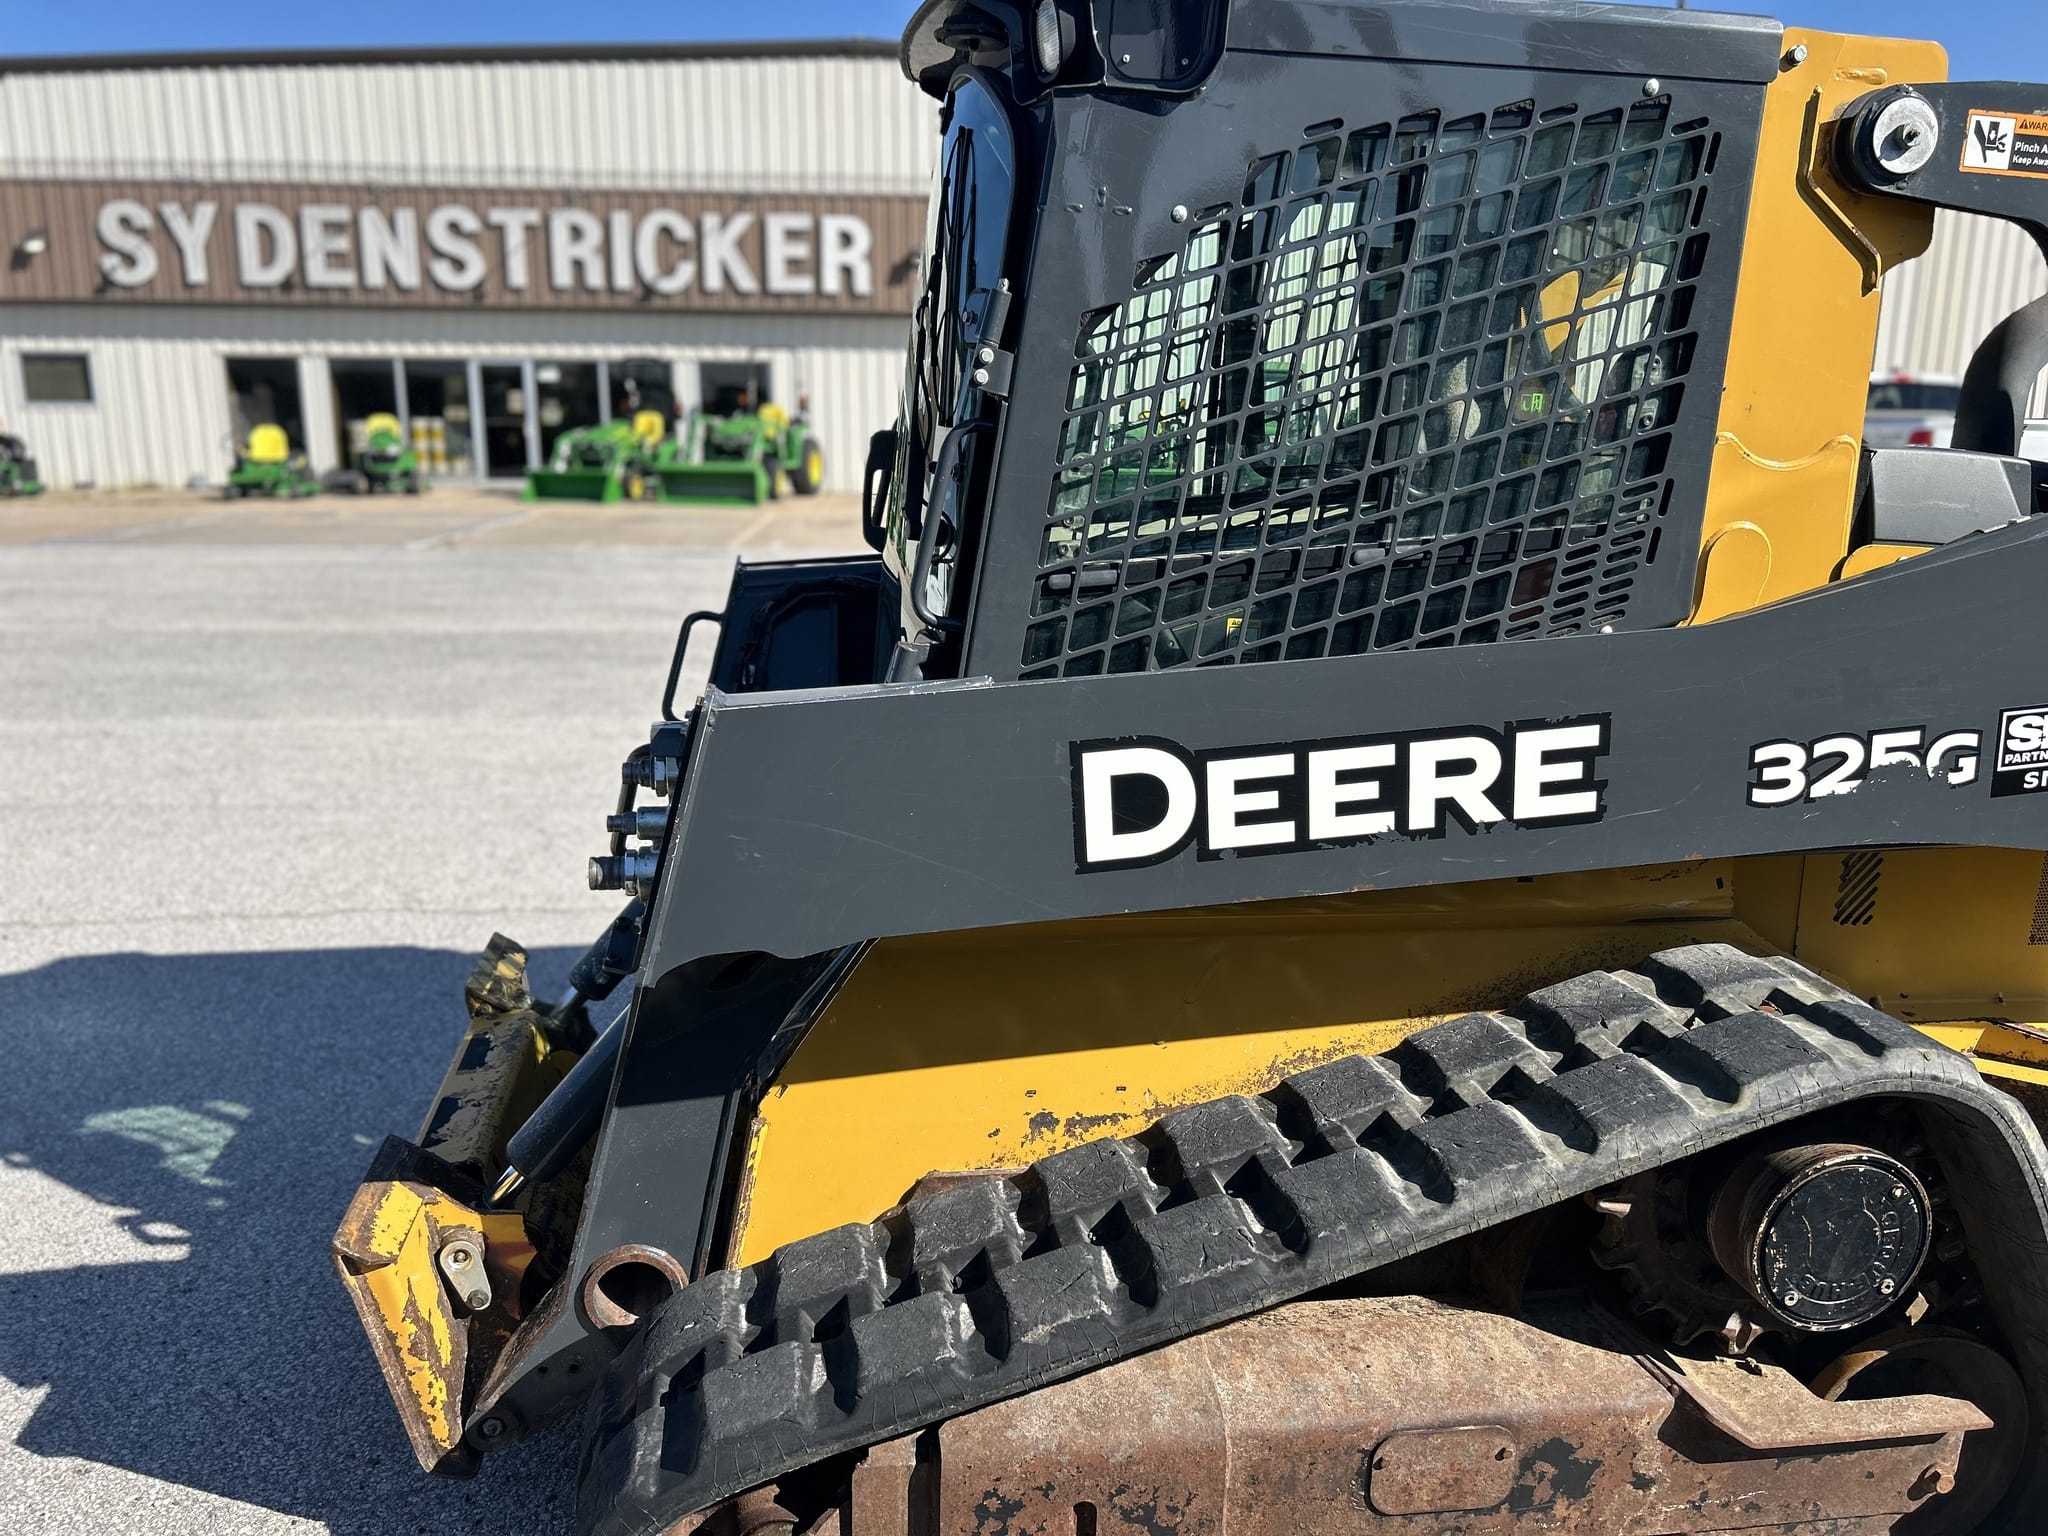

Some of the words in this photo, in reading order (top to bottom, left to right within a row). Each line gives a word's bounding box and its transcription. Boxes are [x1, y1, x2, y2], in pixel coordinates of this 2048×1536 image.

[2012, 154, 2032, 166] Keep
[2015, 142, 2040, 153] Pinch
[1750, 729, 1980, 805] 325G
[1080, 722, 1602, 864] DEERE
